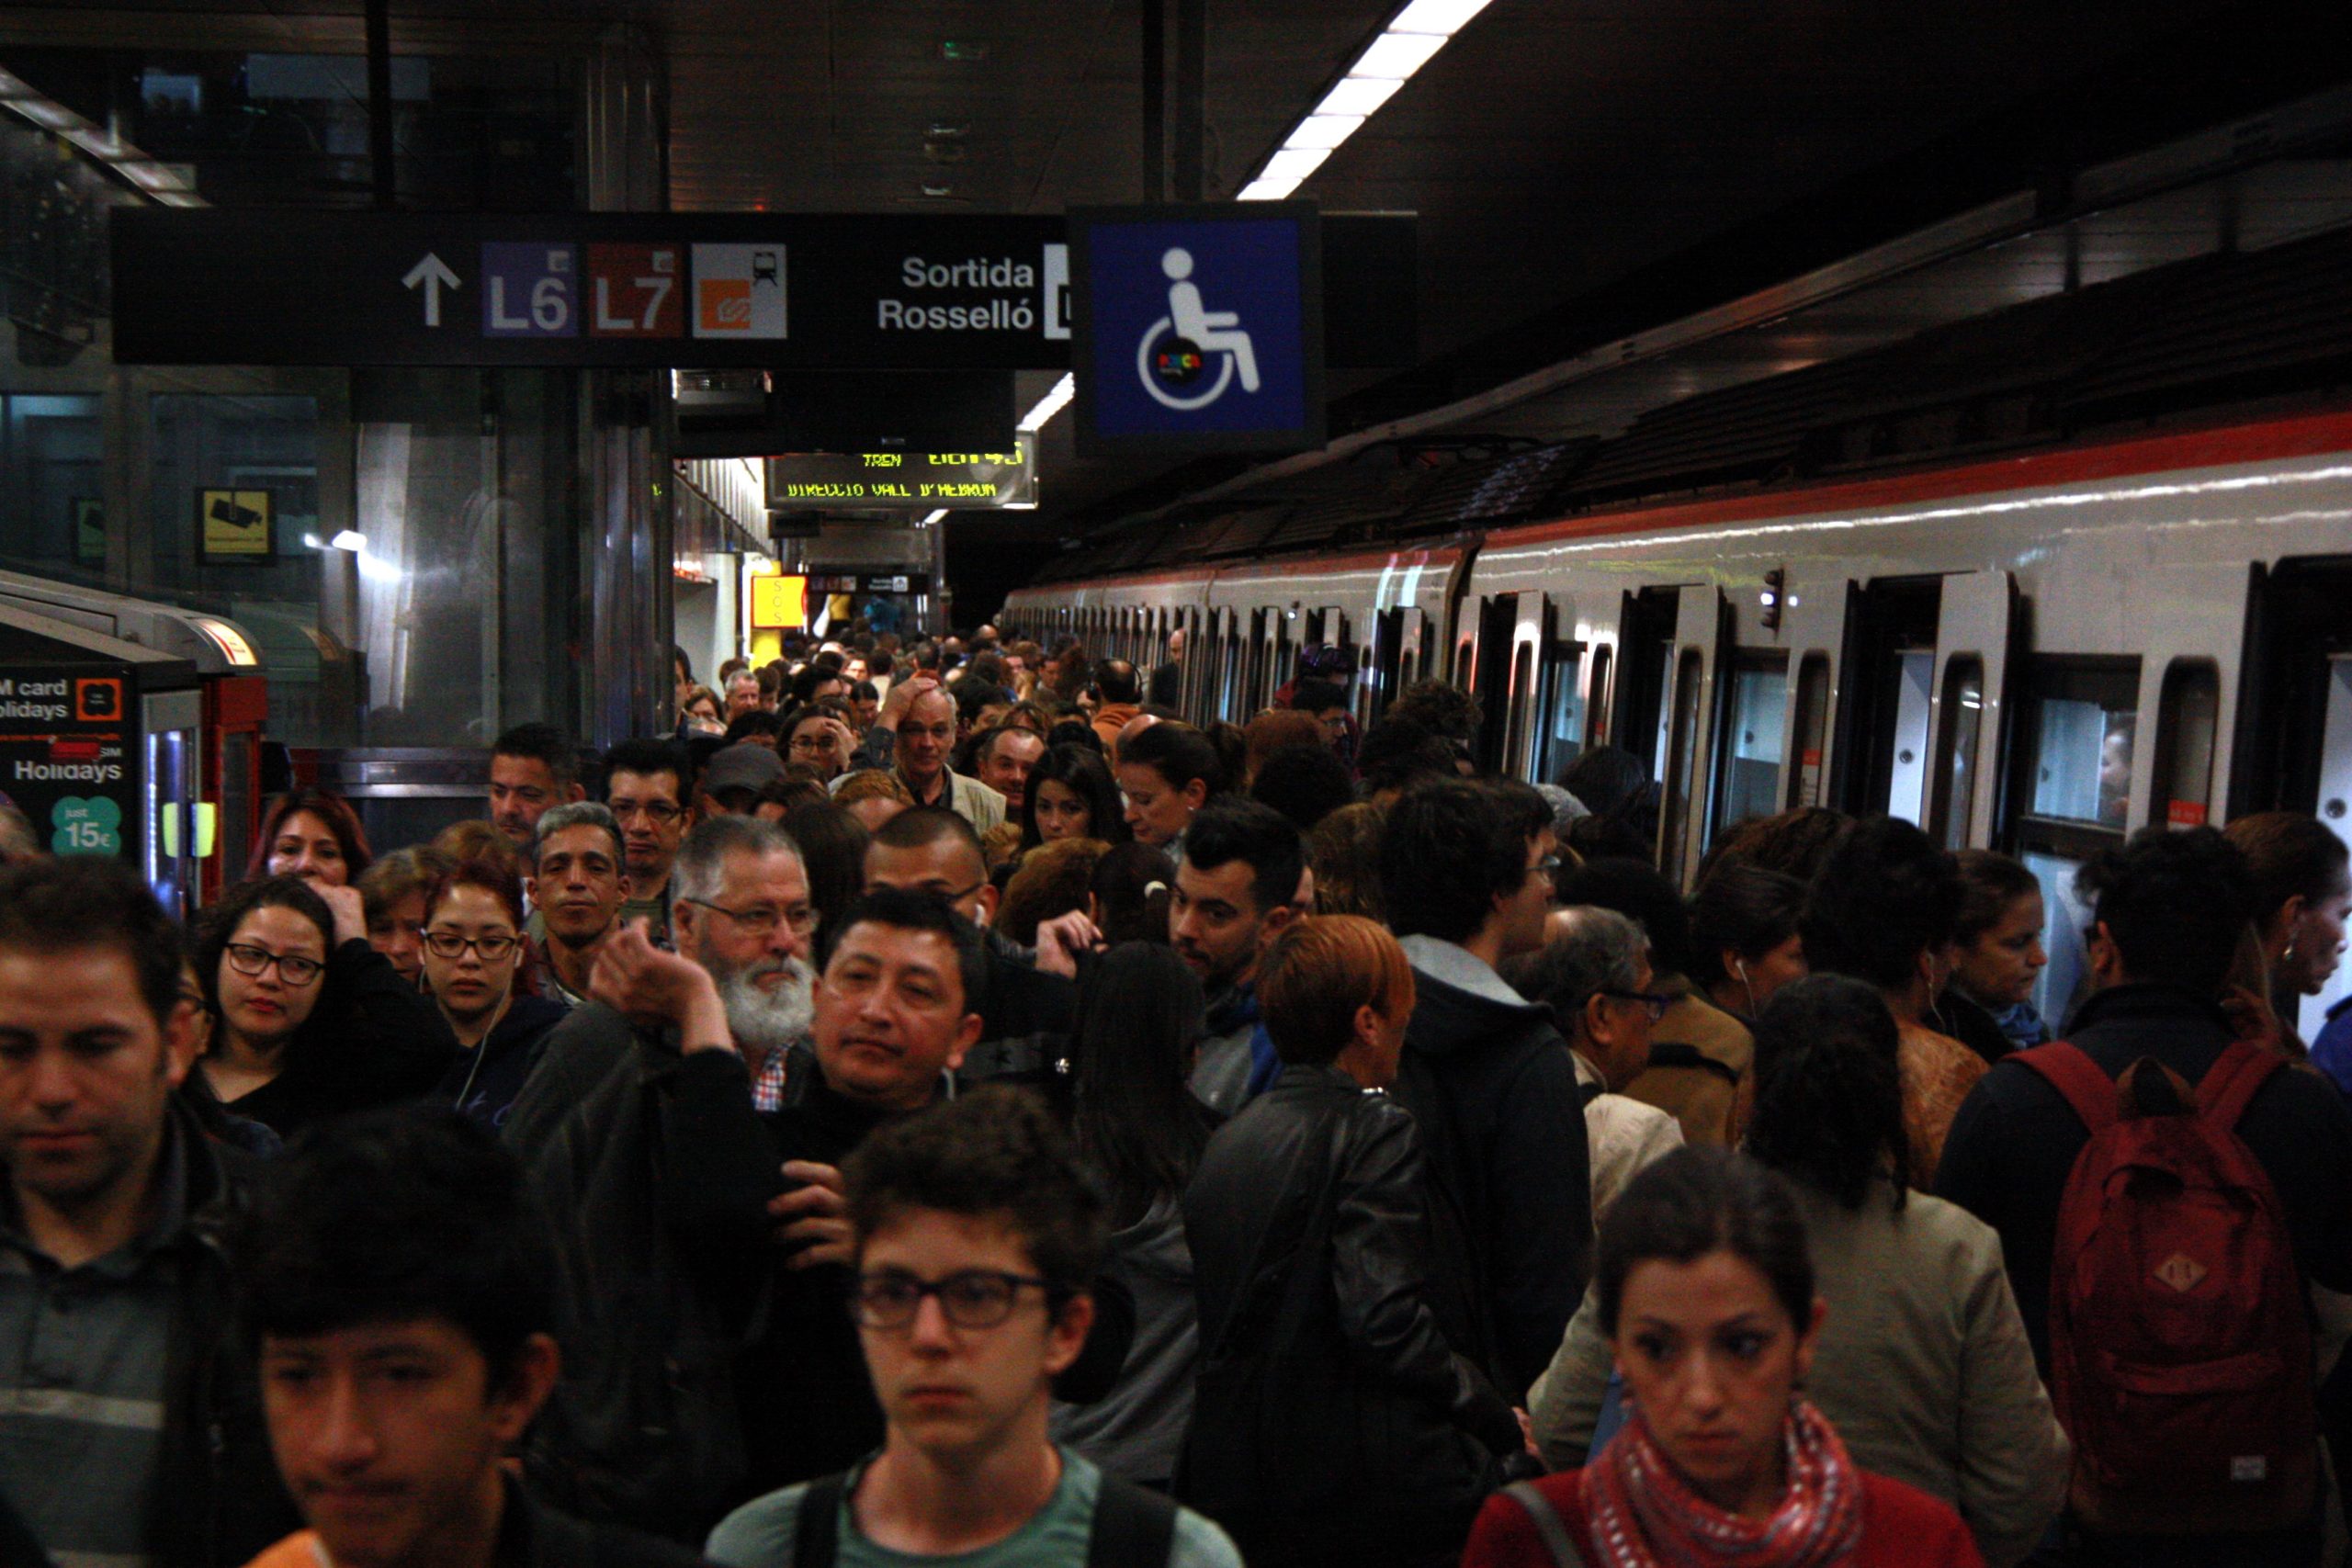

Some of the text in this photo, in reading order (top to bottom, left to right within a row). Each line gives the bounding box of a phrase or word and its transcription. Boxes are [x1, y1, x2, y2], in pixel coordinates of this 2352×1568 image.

[901, 255, 1035, 288] Sortida
[491, 276, 568, 330] L6
[596, 276, 673, 330] L7
[877, 297, 1035, 330] Rosselló
[872, 483, 911, 497] VALL
[773, 580, 783, 624] SOS
[19, 680, 67, 695] card
[100, 748, 120, 757] SIM
[64, 807, 88, 819] just
